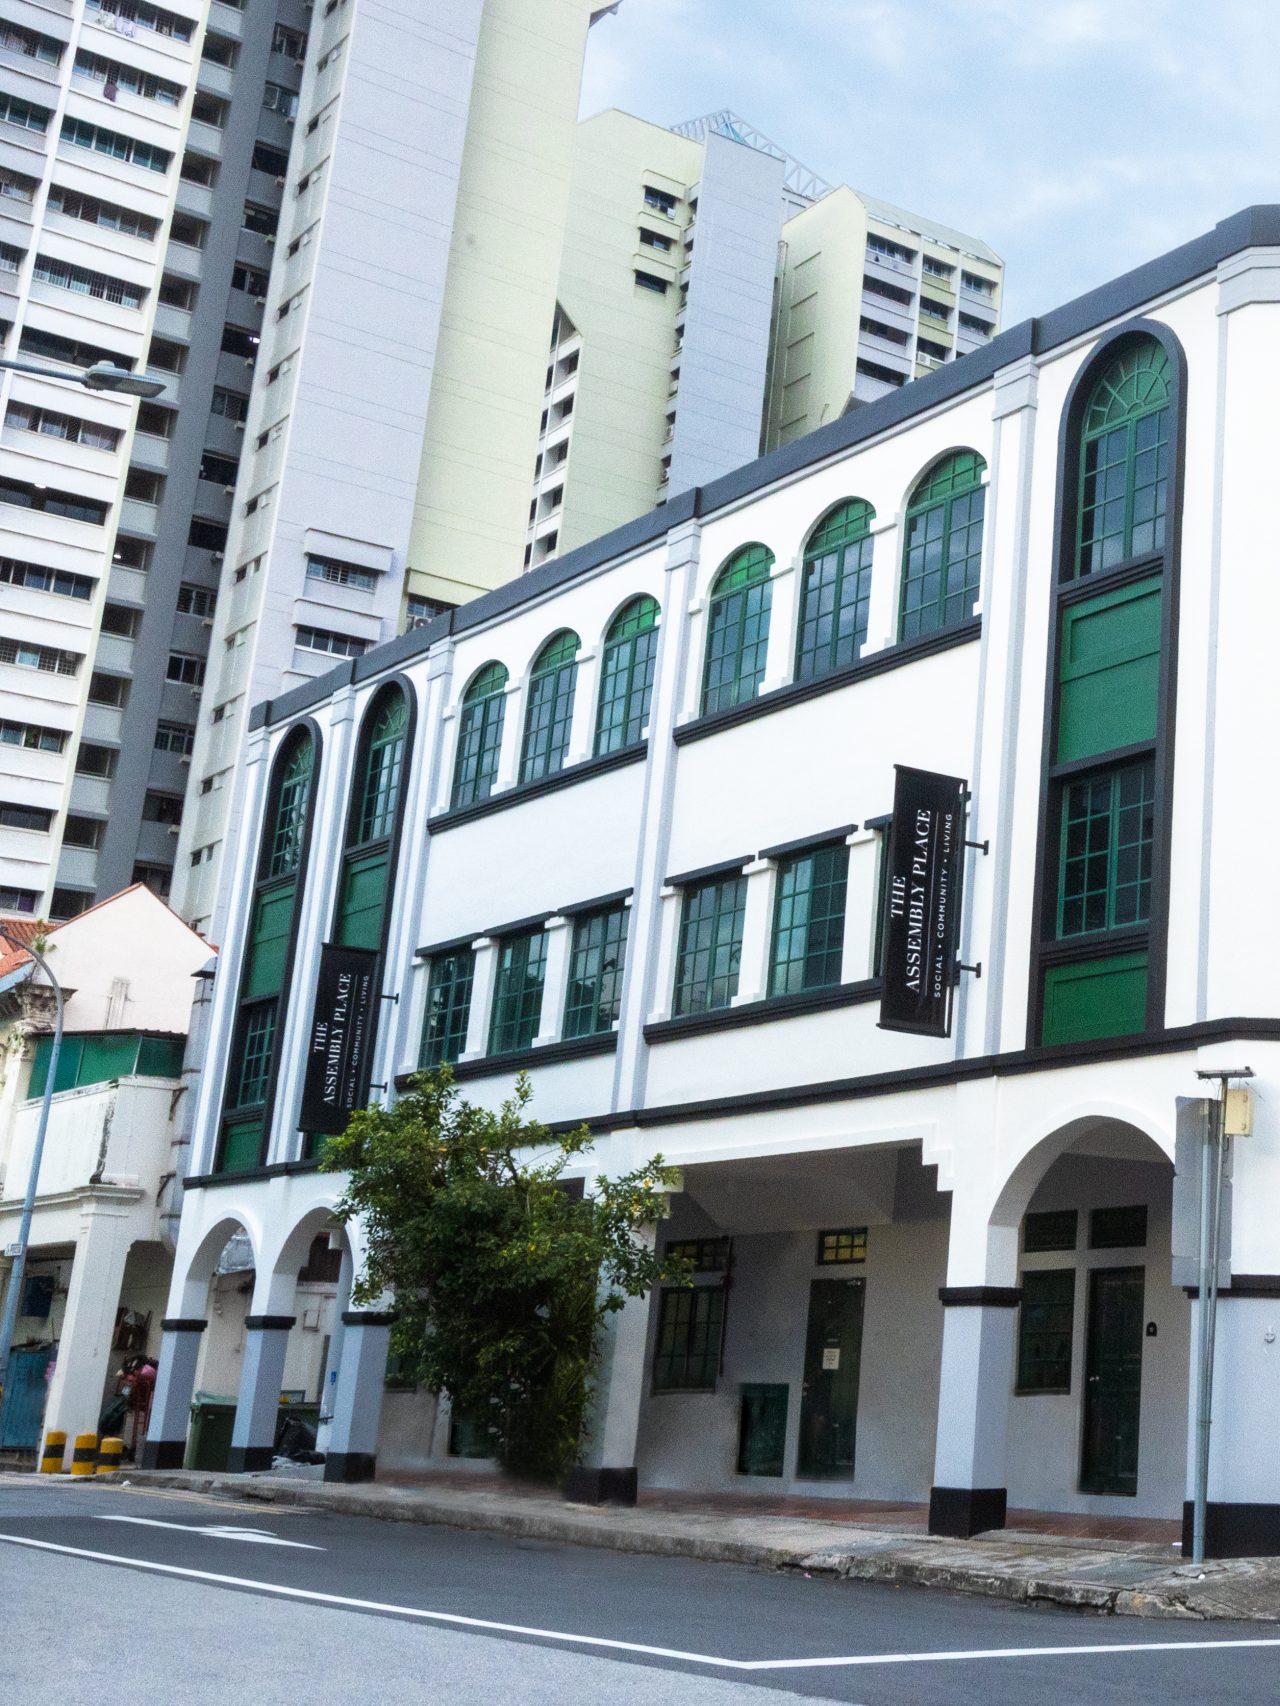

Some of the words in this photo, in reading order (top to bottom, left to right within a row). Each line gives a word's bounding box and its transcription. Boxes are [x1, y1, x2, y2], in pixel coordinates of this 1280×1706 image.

[912, 809, 931, 876] PLACE
[944, 813, 952, 852] LIVING
[891, 876, 906, 918] THE
[937, 868, 947, 938] COMMUNITY
[906, 881, 925, 993] ASSEMBLY
[934, 955, 943, 997] SOCIAL
[314, 1022, 328, 1053] THE
[323, 1026, 344, 1106] ASSEMBLY
[334, 973, 351, 1021] PLACE
[347, 1077, 356, 1108] SOCIAL
[352, 1015, 363, 1066] COMMUNITY
[361, 975, 369, 1004] LIVING
